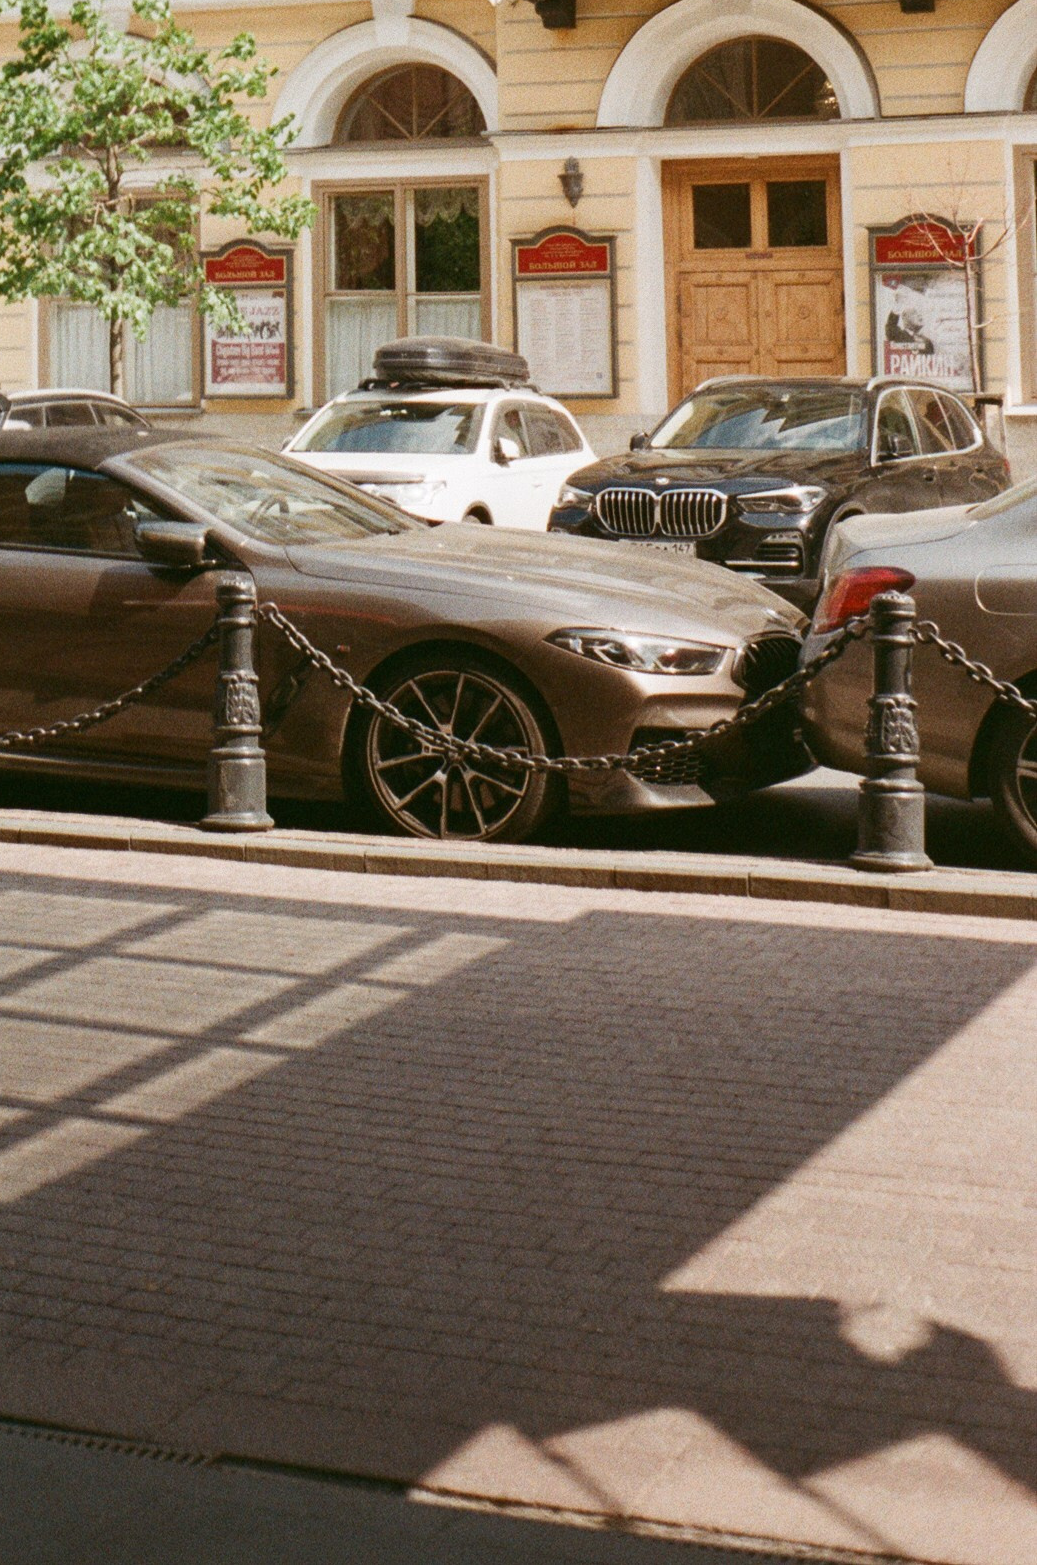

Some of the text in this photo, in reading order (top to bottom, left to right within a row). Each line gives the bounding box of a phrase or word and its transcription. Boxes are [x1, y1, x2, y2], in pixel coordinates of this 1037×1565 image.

[529, 260, 597, 270] БОЛЬШОЙ ЗАЛ
[249, 306, 280, 316] JAZZ
[890, 351, 954, 376] РАЙКИН
